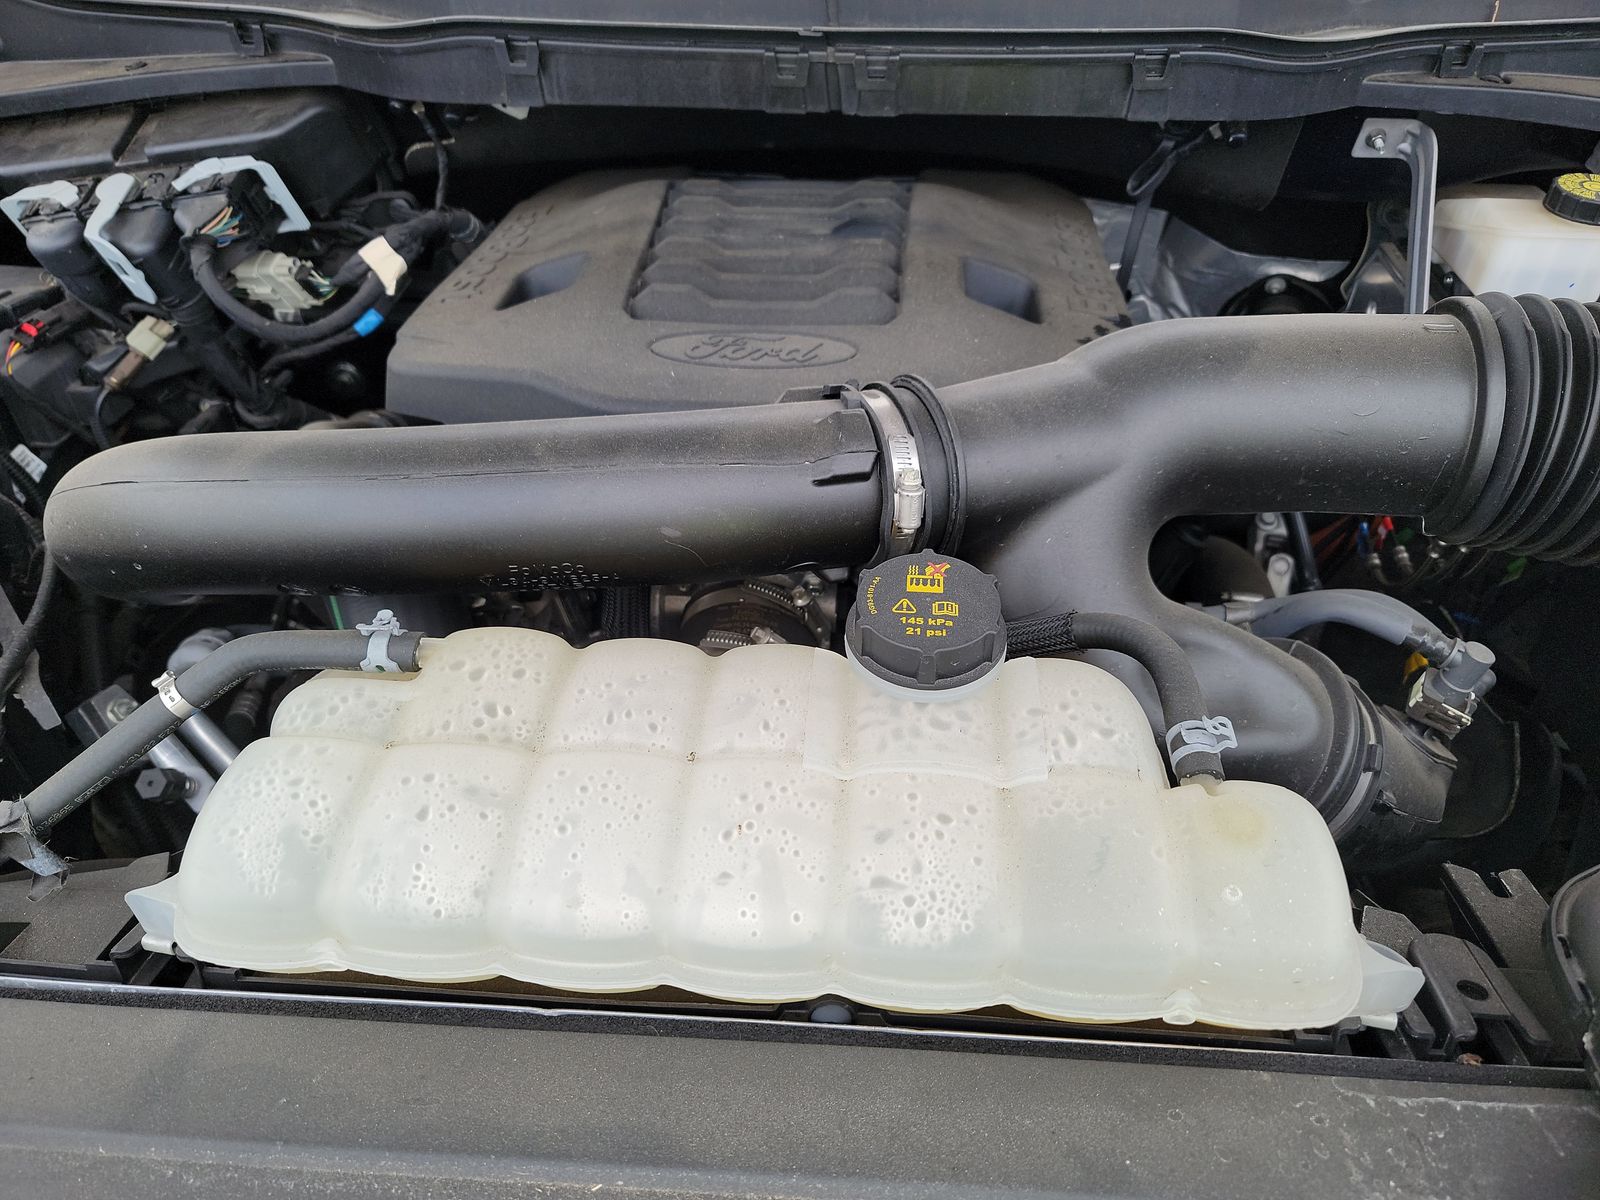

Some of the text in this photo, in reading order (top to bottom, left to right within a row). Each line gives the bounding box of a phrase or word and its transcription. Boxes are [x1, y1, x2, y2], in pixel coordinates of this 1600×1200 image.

[684, 335, 824, 364] Ford
[899, 616, 954, 627] 145 kPa
[905, 627, 947, 637] 21 psi
